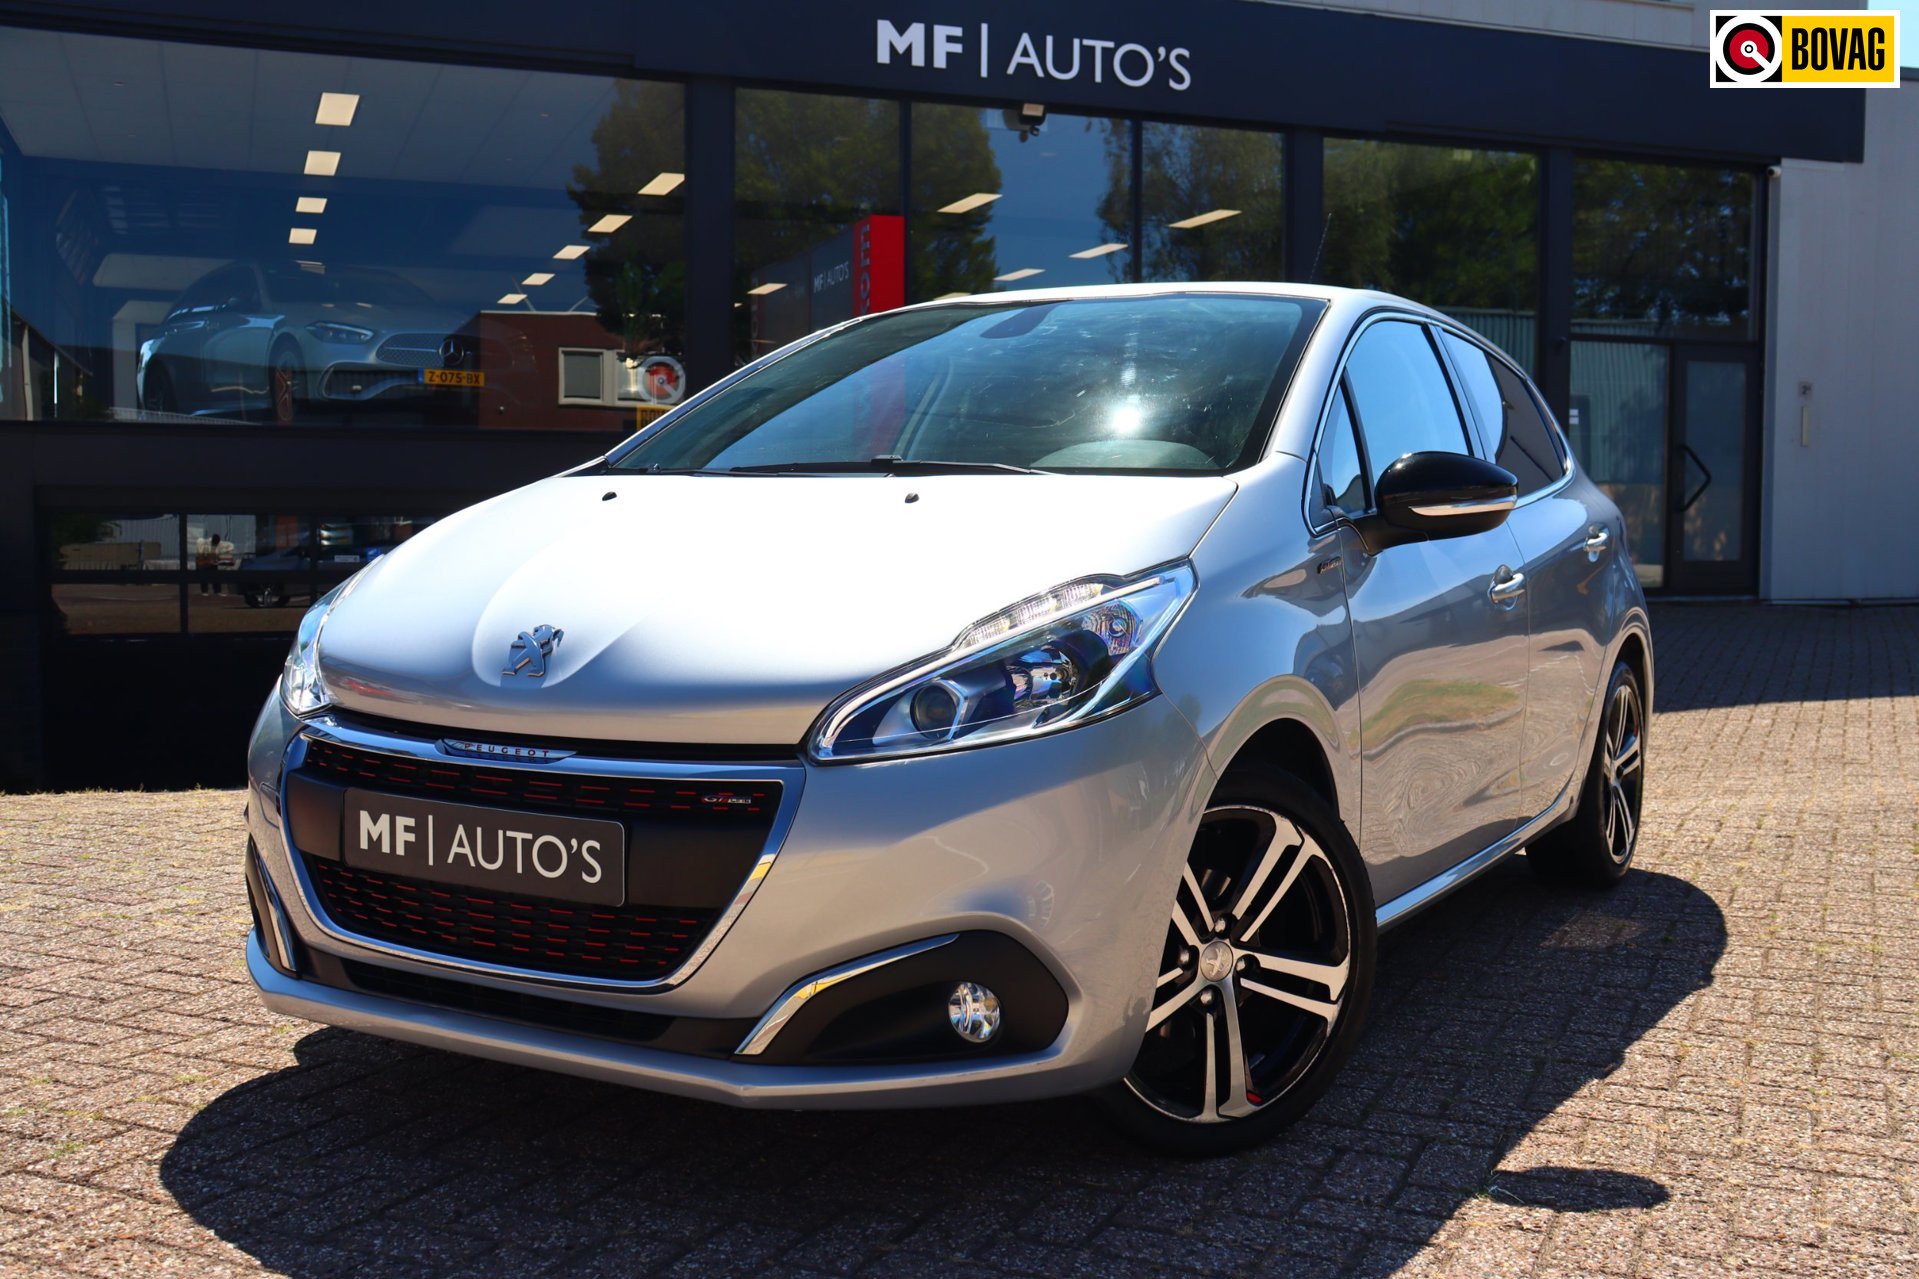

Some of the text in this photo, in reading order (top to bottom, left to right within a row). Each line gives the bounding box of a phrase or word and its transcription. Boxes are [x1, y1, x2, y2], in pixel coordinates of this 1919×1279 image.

[877, 19, 1191, 91] MF AUTO'S
[813, 273, 825, 293] MF
[464, 742, 549, 757] PEUGEOT
[359, 810, 602, 884] MF AUTO'S
